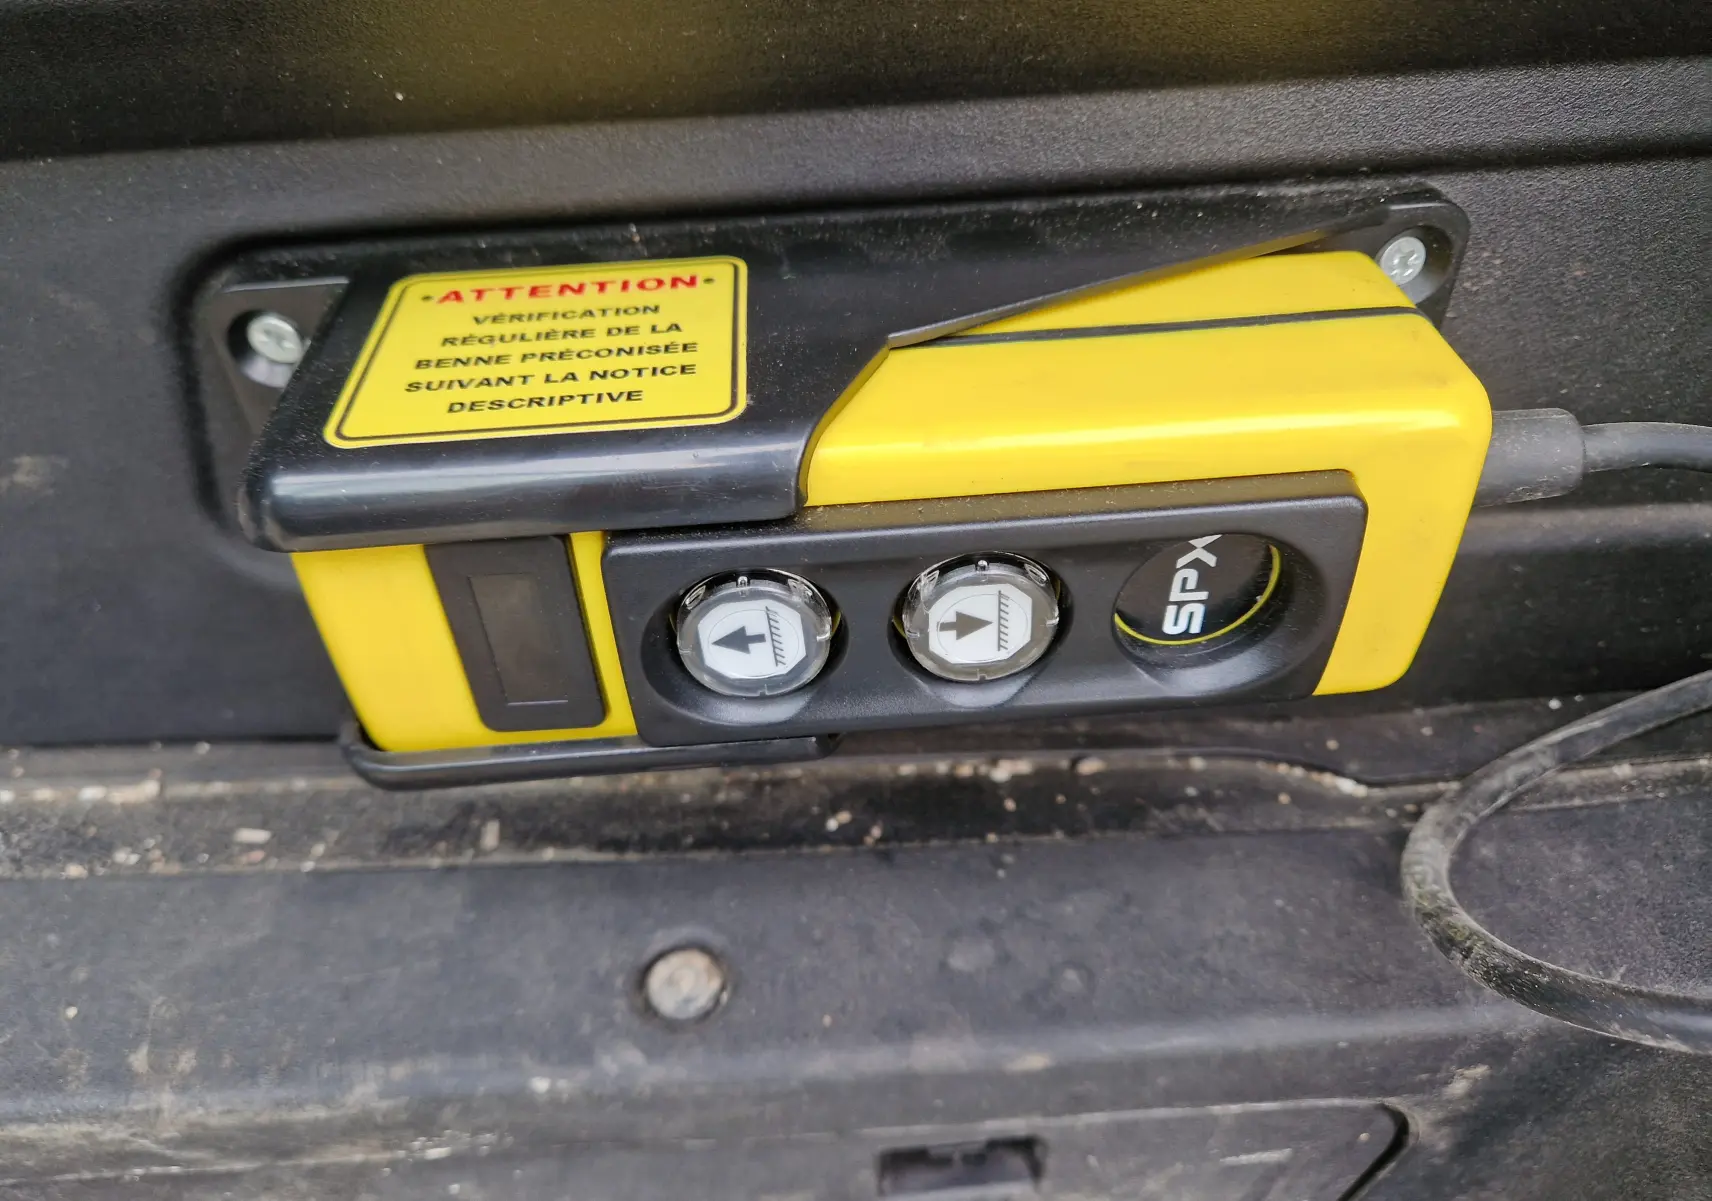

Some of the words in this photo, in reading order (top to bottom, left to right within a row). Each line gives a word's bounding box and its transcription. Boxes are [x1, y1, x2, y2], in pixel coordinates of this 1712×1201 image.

[437, 275, 698, 304] ATTENTION
[473, 304, 661, 325] VÉRIFICATION
[441, 327, 597, 347] RÉGULIÈRE
[606, 325, 641, 337] DE
[650, 321, 683, 334] LA
[414, 353, 510, 370] BENNE
[520, 341, 698, 364] PRÉCONISÉE
[404, 374, 535, 392] SUIVANT
[544, 372, 579, 384] LA
[589, 364, 697, 380] NOTICE
[446, 390, 644, 413] DESCRIPTIVE
[1161, 534, 1223, 635] SPX
